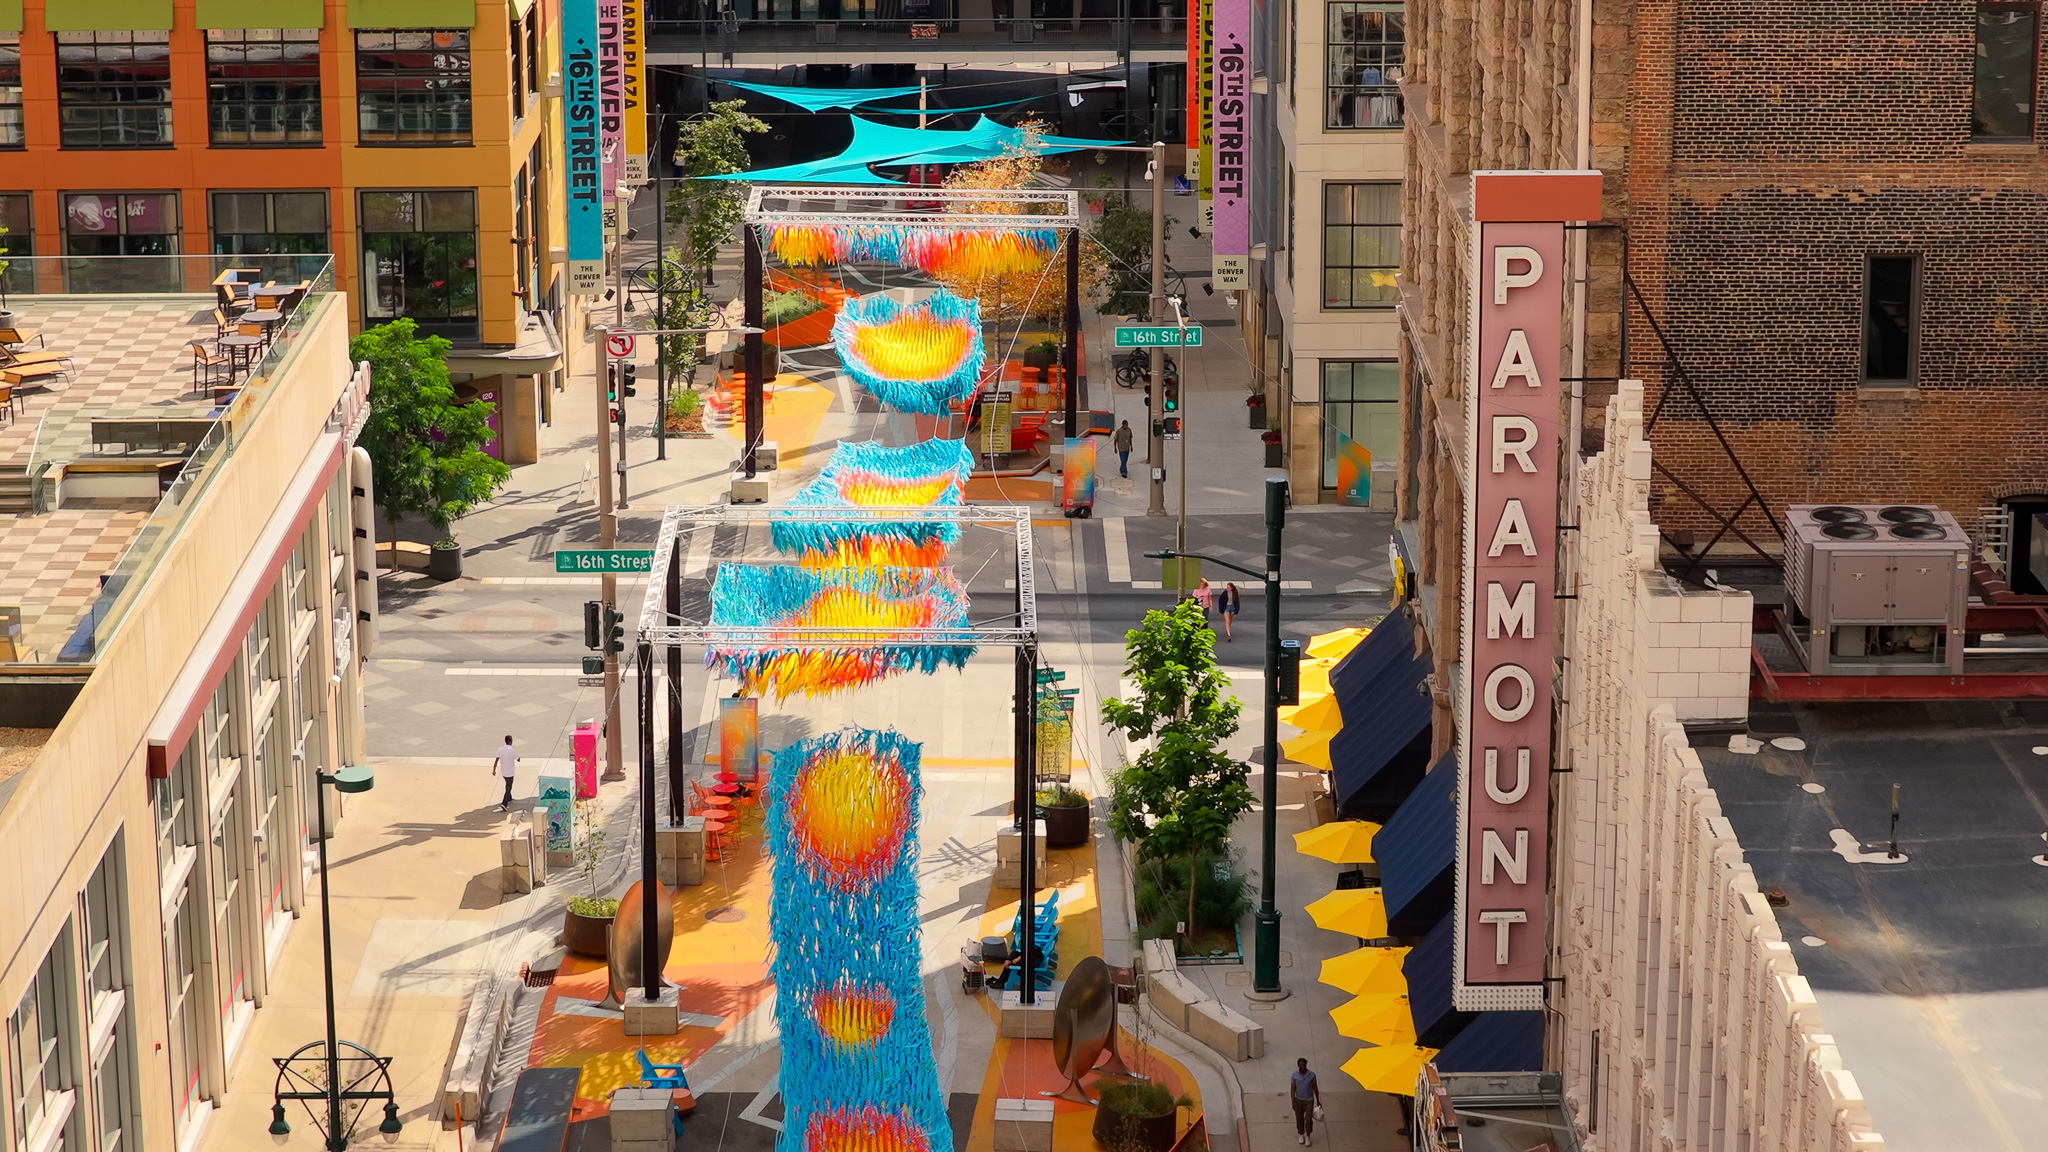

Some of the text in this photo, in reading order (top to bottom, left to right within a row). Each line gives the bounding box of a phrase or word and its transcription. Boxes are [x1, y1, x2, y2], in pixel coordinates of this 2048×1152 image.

[600, 5, 618, 18] HE
[599, 22, 620, 133] DENVER
[624, 51, 638, 110] PLAZA
[569, 48, 598, 204] 16TH STREET
[1219, 43, 1244, 198] 16TH STREET
[573, 273, 601, 281] DENVER
[579, 281, 596, 289] WAY
[1132, 331, 1157, 343] 16th
[575, 554, 653, 569] 16th Street
[1478, 244, 1545, 966] PARAMOUNT
